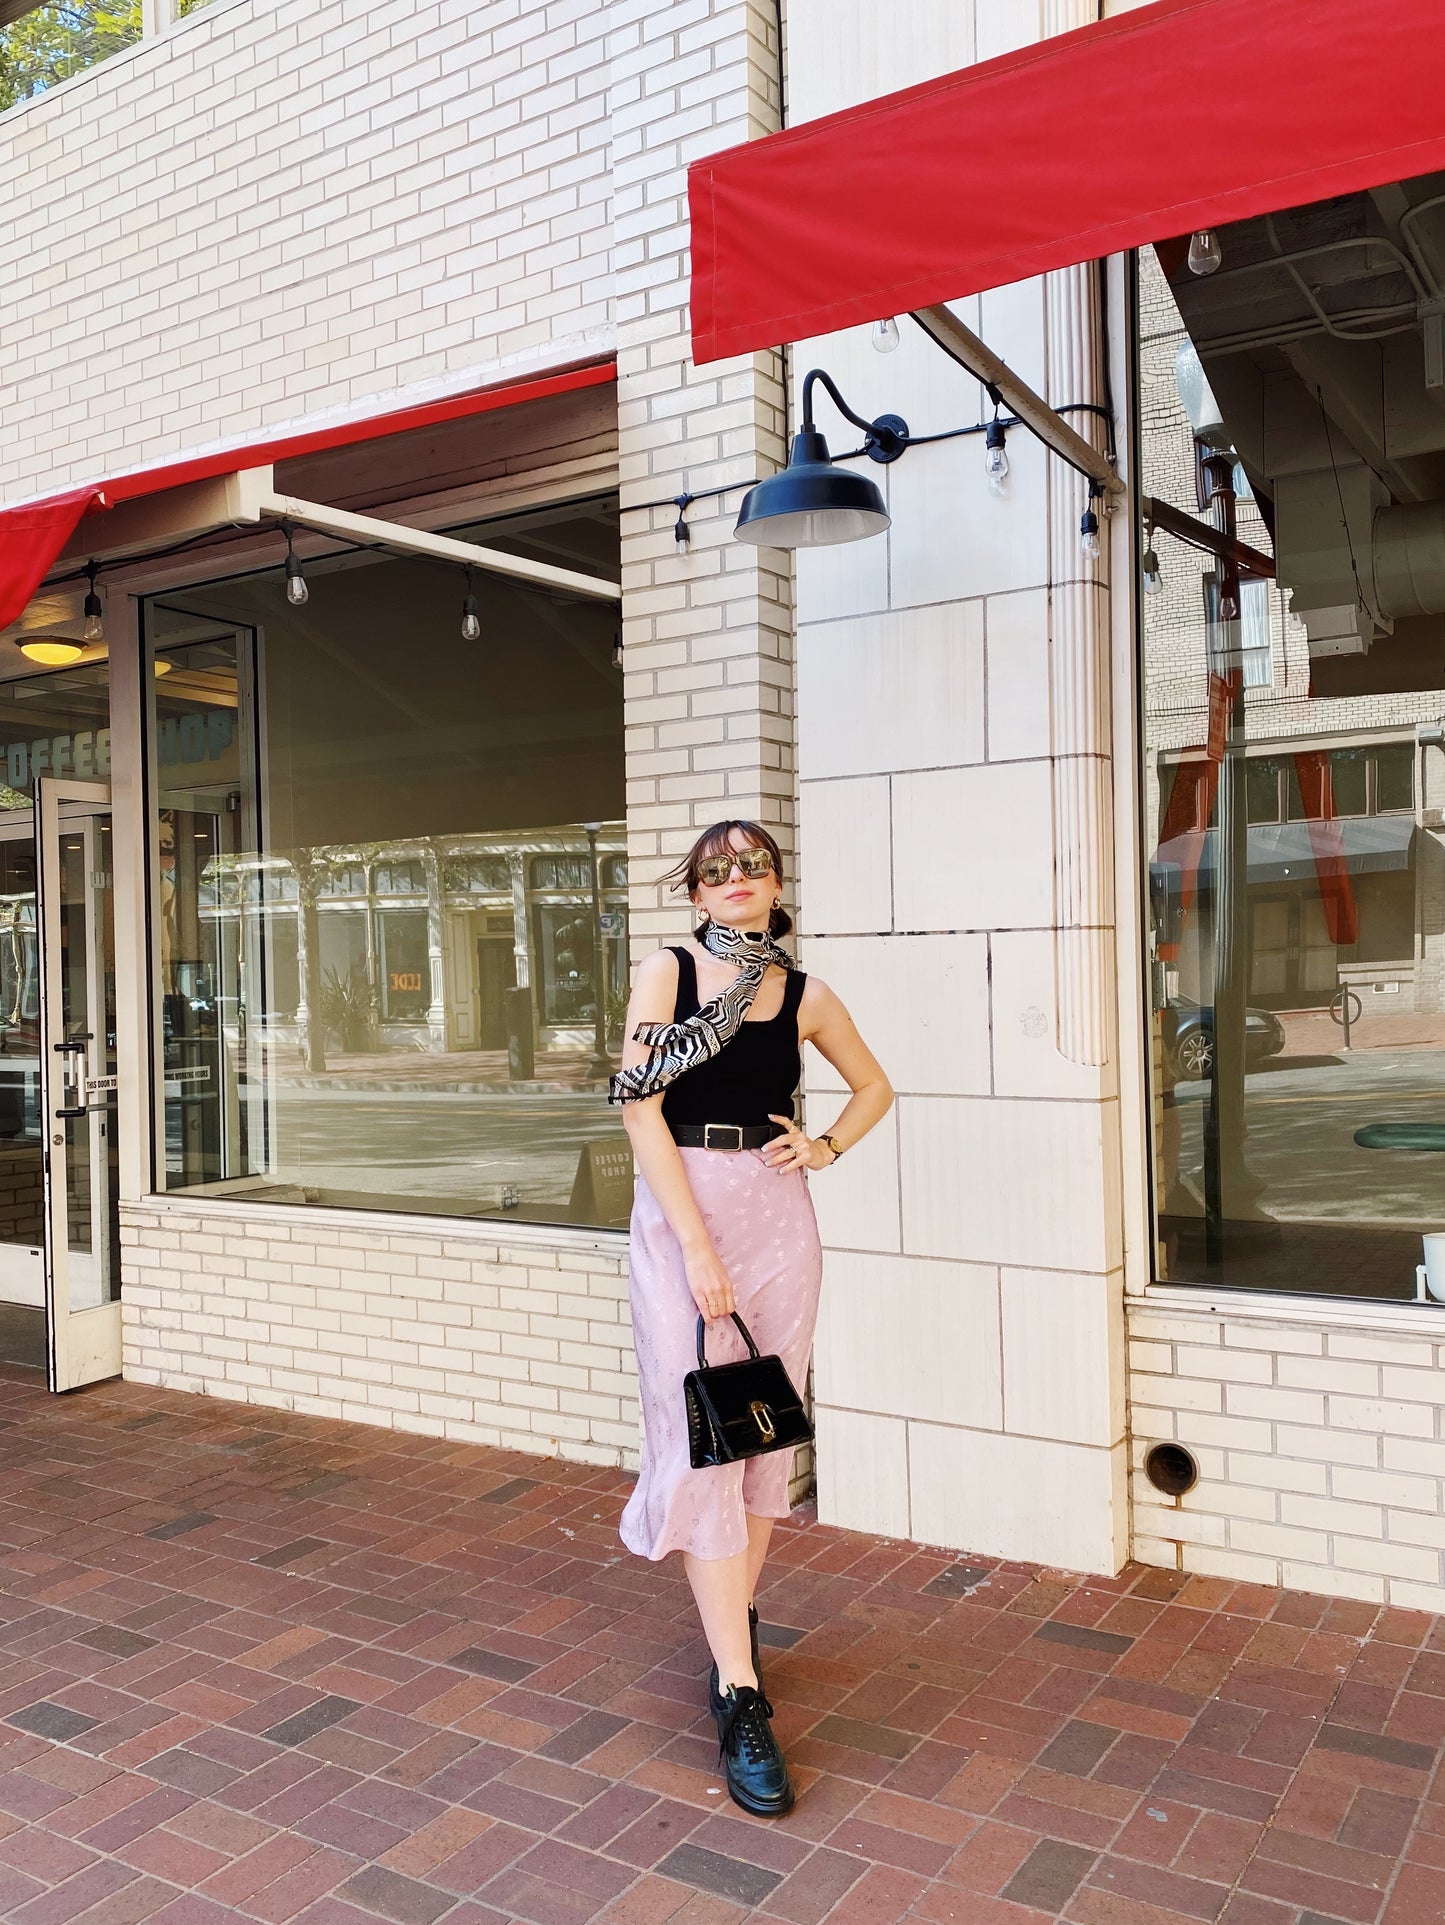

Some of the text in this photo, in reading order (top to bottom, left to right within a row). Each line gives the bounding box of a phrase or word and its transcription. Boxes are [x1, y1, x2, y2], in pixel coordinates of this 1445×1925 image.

[0, 708, 232, 788] OFFEE HOP
[87, 1081, 97, 1089] THIS
[98, 1080, 110, 1088] DOOR
